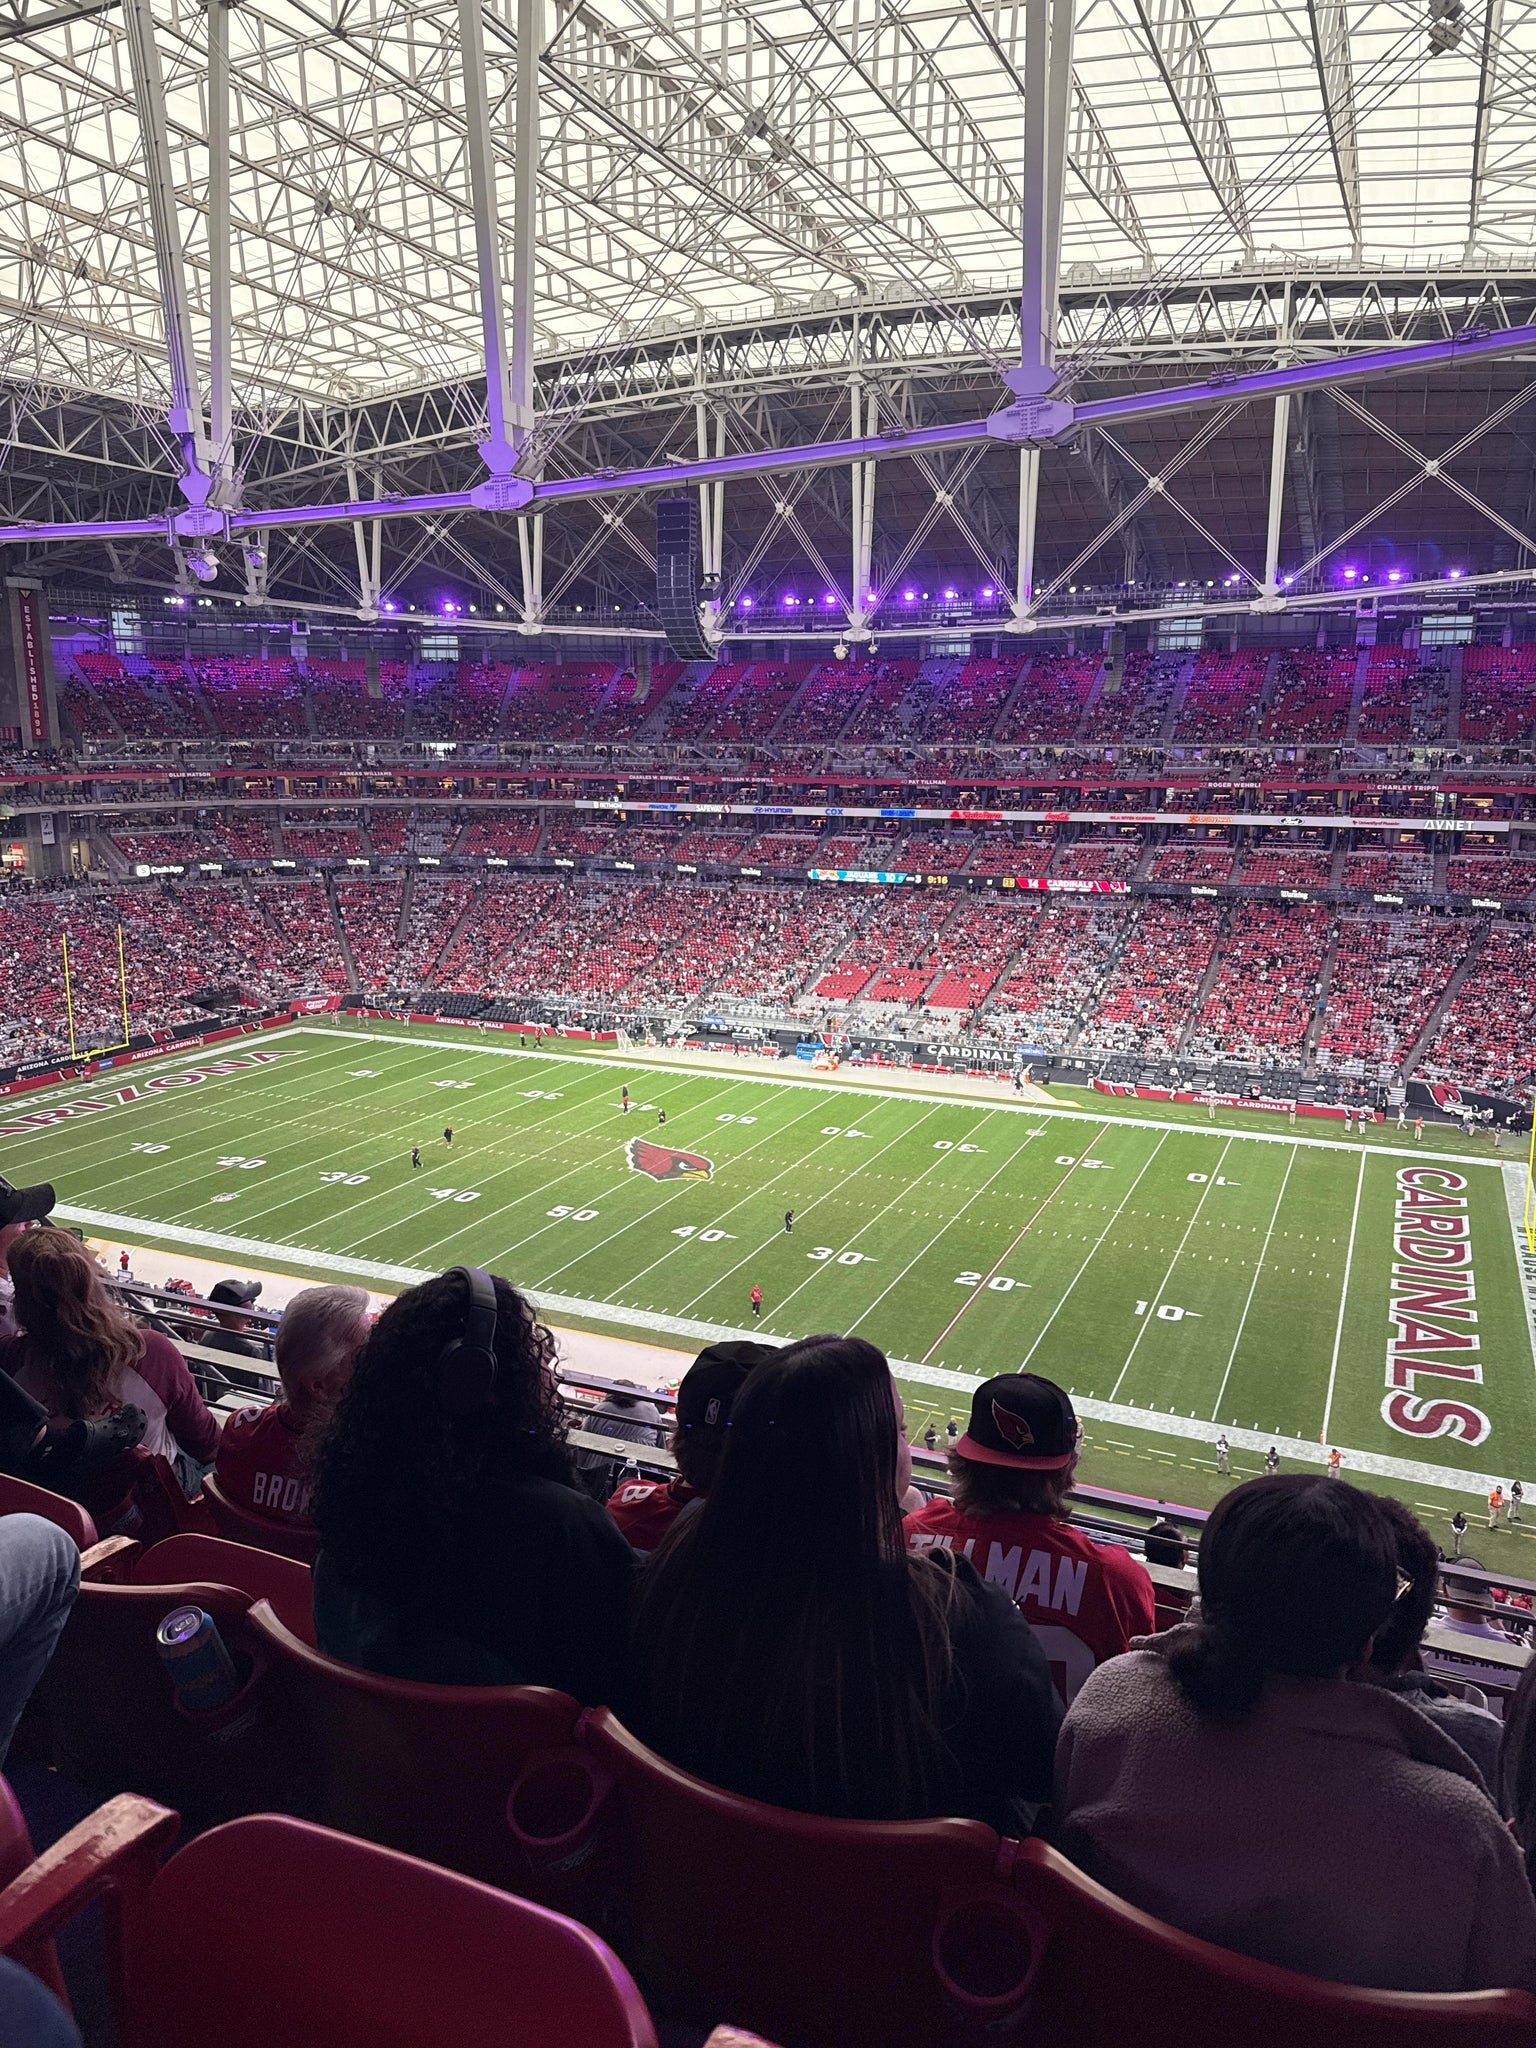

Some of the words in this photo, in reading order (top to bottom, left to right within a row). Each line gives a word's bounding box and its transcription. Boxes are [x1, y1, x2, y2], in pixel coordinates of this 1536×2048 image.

[24, 605, 39, 701] ESTABLISHED
[33, 701, 42, 737] 1898
[695, 804, 723, 812] SAFEWAY
[1424, 820, 1475, 831] AVNET
[886, 873, 896, 882] 10
[927, 875, 948, 884] 9:16
[1028, 879, 1039, 888] 14
[1046, 880, 1093, 889] CARDINALS
[435, 1017, 465, 1025] ARIZONA
[131, 1048, 164, 1060] ARIZONA
[165, 1038, 201, 1052] CARDINAL
[927, 1044, 1023, 1063] CARDINALS
[16, 1061, 49, 1073] ARIZONA
[1192, 1096, 1233, 1106] ARIONA
[1236, 1100, 1288, 1111] CARDINALS
[715, 1113, 758, 1125] 50
[216, 1156, 267, 1169] 20
[320, 1171, 371, 1185] 30
[430, 1188, 482, 1203] 40
[546, 1205, 600, 1221] 50
[671, 1225, 727, 1242] 40
[807, 1246, 865, 1265] 30
[953, 1271, 1016, 1291] 20
[1134, 1300, 1185, 1321] 10
[1380, 1166, 1492, 1447] CARDINALS
